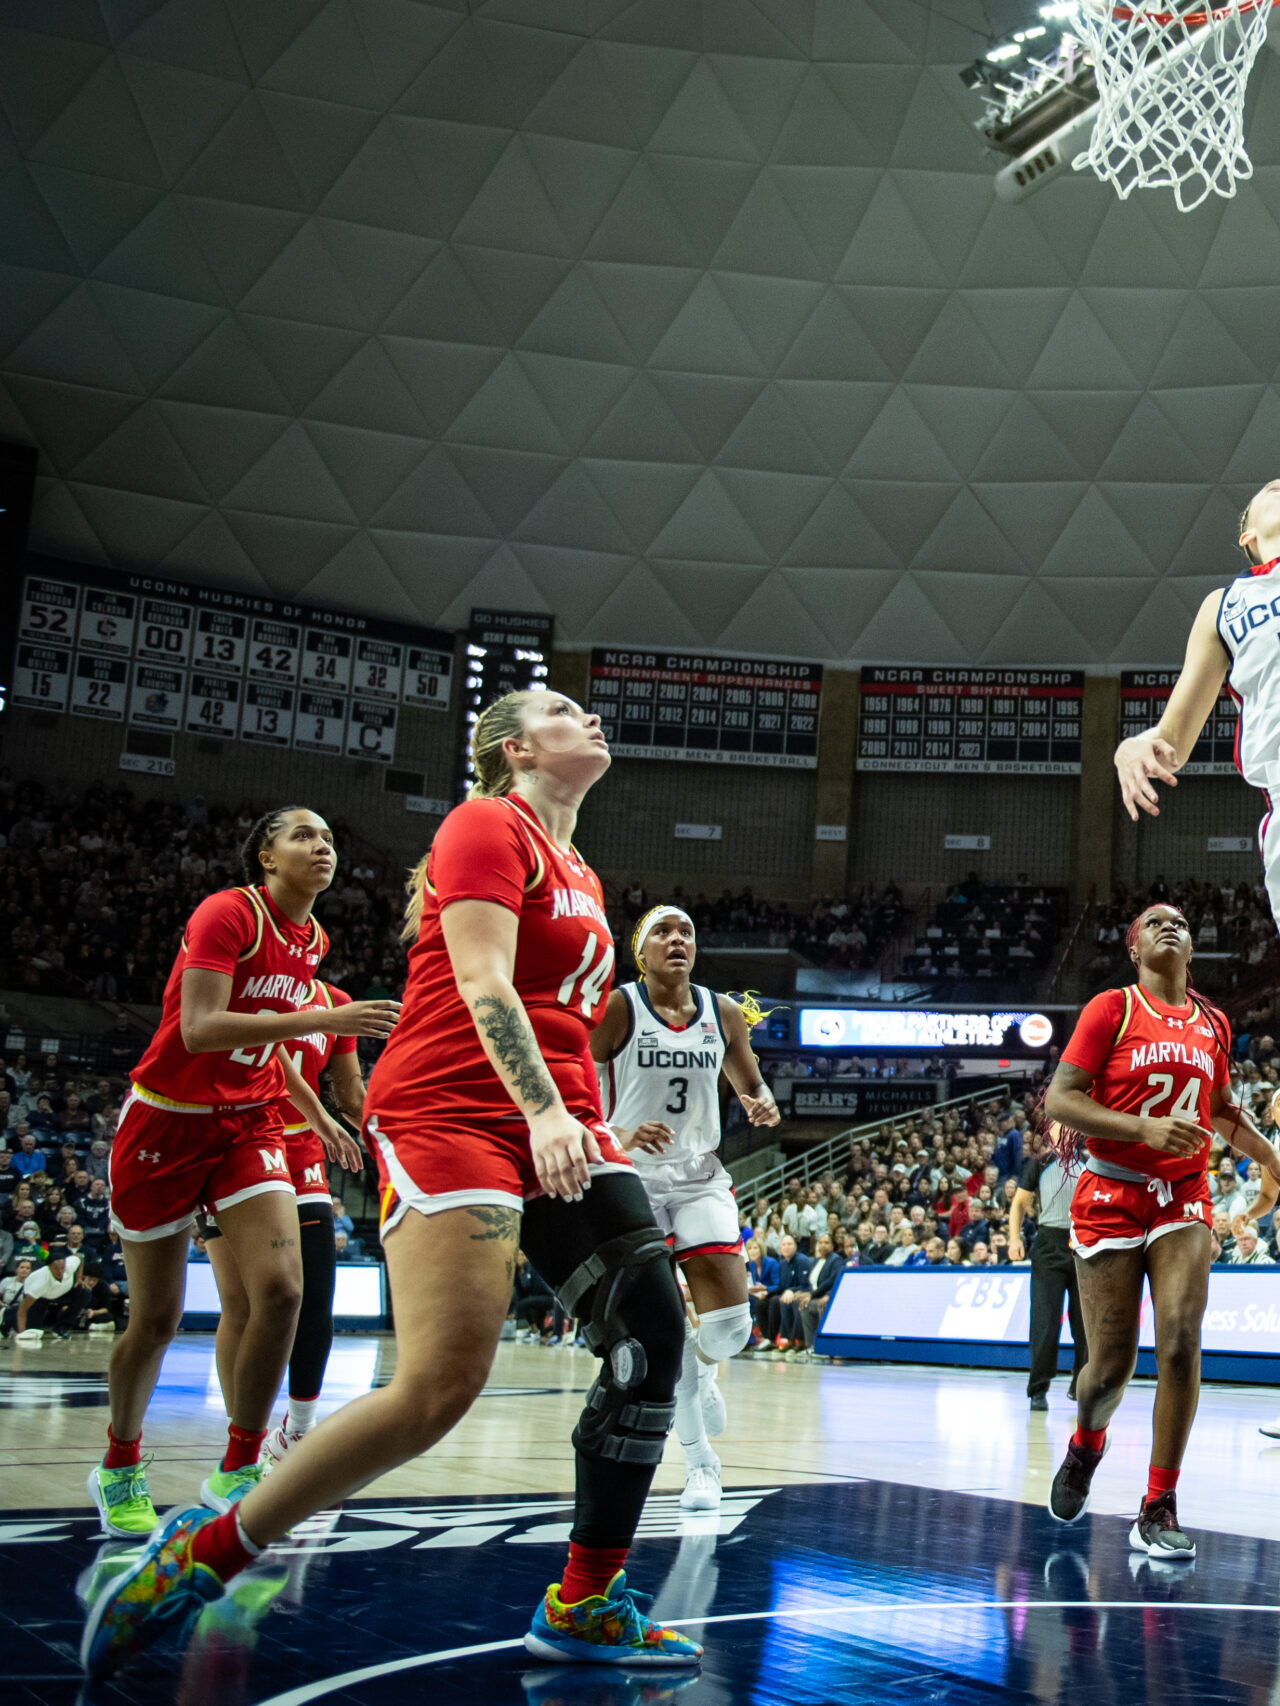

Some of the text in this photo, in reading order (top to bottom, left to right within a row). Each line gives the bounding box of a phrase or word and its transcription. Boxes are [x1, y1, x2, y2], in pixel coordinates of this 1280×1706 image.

[129, 576, 368, 629] UCONN HUSKIES OF HONOR
[29, 604, 68, 633] 52
[145, 626, 183, 652] 00
[203, 635, 235, 661] 13
[255, 646, 292, 672] 42
[315, 655, 336, 680] 34
[605, 652, 810, 678] NCAA CHAMPIONSHIP
[30, 671, 52, 697] 15
[367, 665, 388, 688] 32
[416, 673, 439, 697] 50
[602, 667, 812, 691] TOURNAMENT APPEARANCES
[874, 669, 1072, 684] NCAA CHAMPIONSHIP
[87, 681, 111, 707] 22
[916, 684, 1029, 696] SWEET SIXTEEN
[199, 700, 224, 725] 42
[256, 708, 279, 733] 13
[625, 704, 650, 720] 2011
[658, 706, 683, 722] 2012
[691, 708, 717, 725] 2014
[790, 715, 815, 731] 2022
[315, 717, 325, 740] 3
[359, 724, 382, 751] C
[958, 720, 983, 736] 2002
[610, 745, 679, 759] NNECTICUT
[729, 753, 810, 766] BASKETBALL
[894, 741, 918, 756] 2011
[925, 741, 950, 757] 2014
[147, 760, 173, 773] 216
[862, 760, 949, 770] CONNECTICUT
[996, 762, 1075, 773] BASKETBALL
[1239, 840, 1247, 850] 9
[551, 888, 613, 940] MARY
[556, 930, 615, 1018] 14
[637, 1050, 717, 1069] UCONN
[1129, 1041, 1214, 1081] MARYLAND
[666, 1077, 689, 1114] 3
[795, 1091, 931, 1107] BEAR'S MICHAELS
[1139, 1072, 1201, 1121] 24
